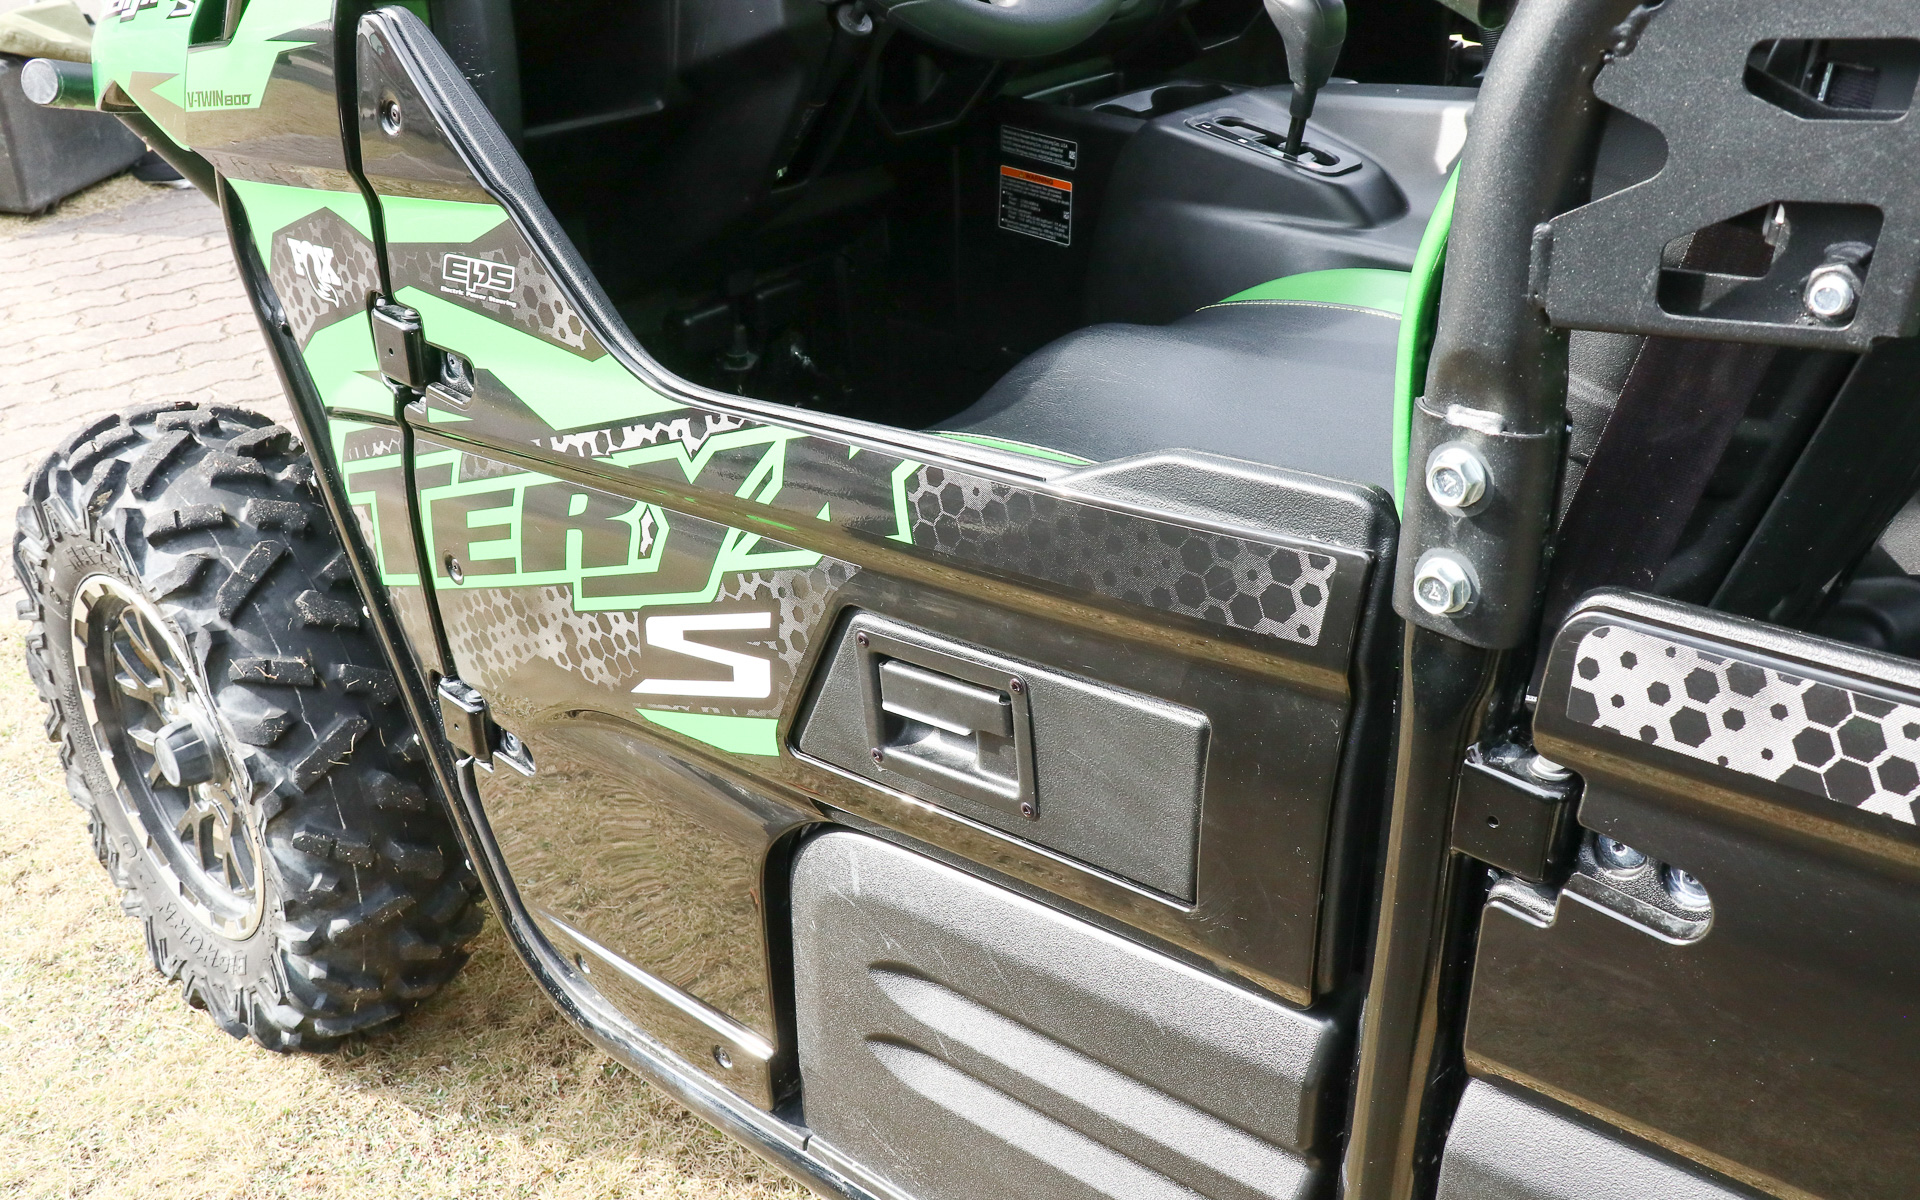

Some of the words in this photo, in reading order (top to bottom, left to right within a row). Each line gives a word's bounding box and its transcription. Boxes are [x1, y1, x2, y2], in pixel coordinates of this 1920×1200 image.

[1025, 174, 1054, 186] WARNING
[286, 237, 342, 308] FOX
[442, 253, 515, 293] EPS
[631, 611, 772, 699] S
